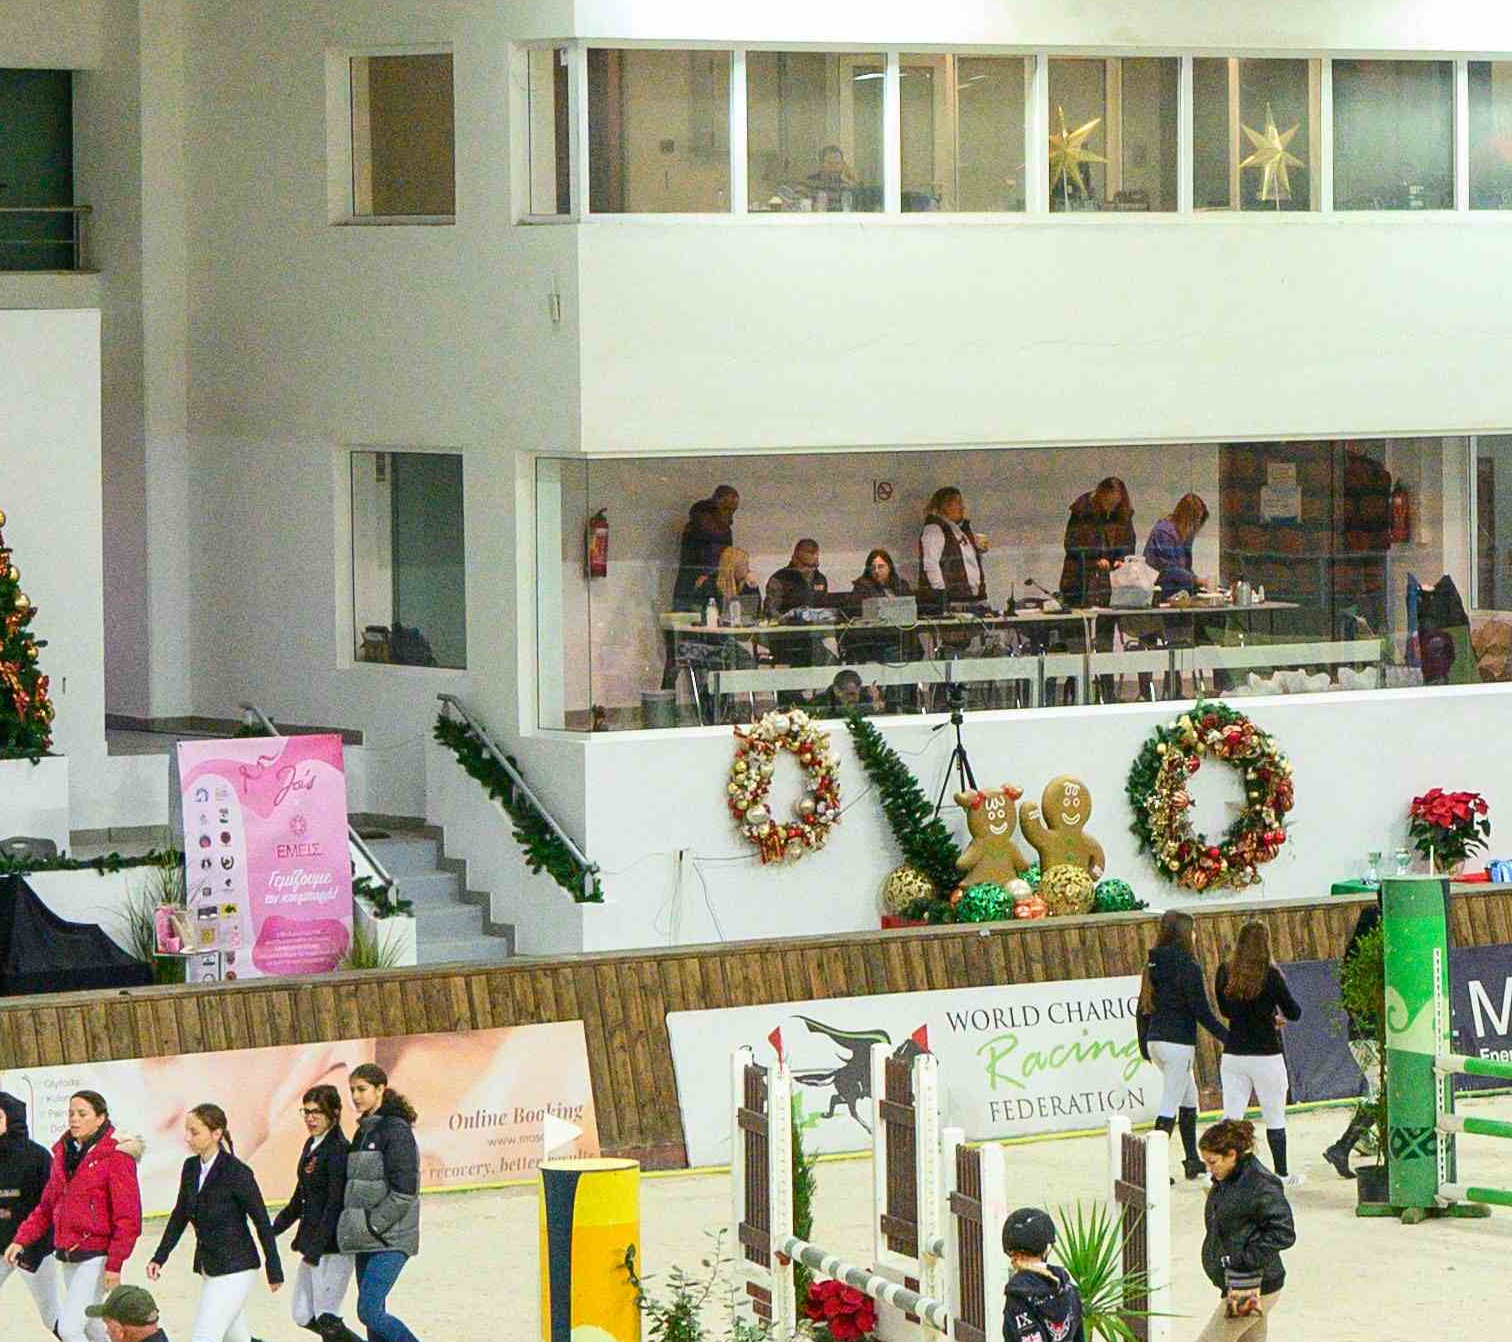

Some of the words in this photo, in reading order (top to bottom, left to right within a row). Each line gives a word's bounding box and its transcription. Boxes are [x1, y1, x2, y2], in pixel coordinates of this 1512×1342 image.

[946, 1004, 1041, 1033] WORLD
[1048, 995, 1139, 1025] CHARIO
[976, 1028, 1144, 1091] Racing
[448, 1109, 508, 1131] Online
[513, 1102, 584, 1125] Booking
[989, 1087, 1146, 1123] FEDERATION
[500, 1155, 544, 1173] better
